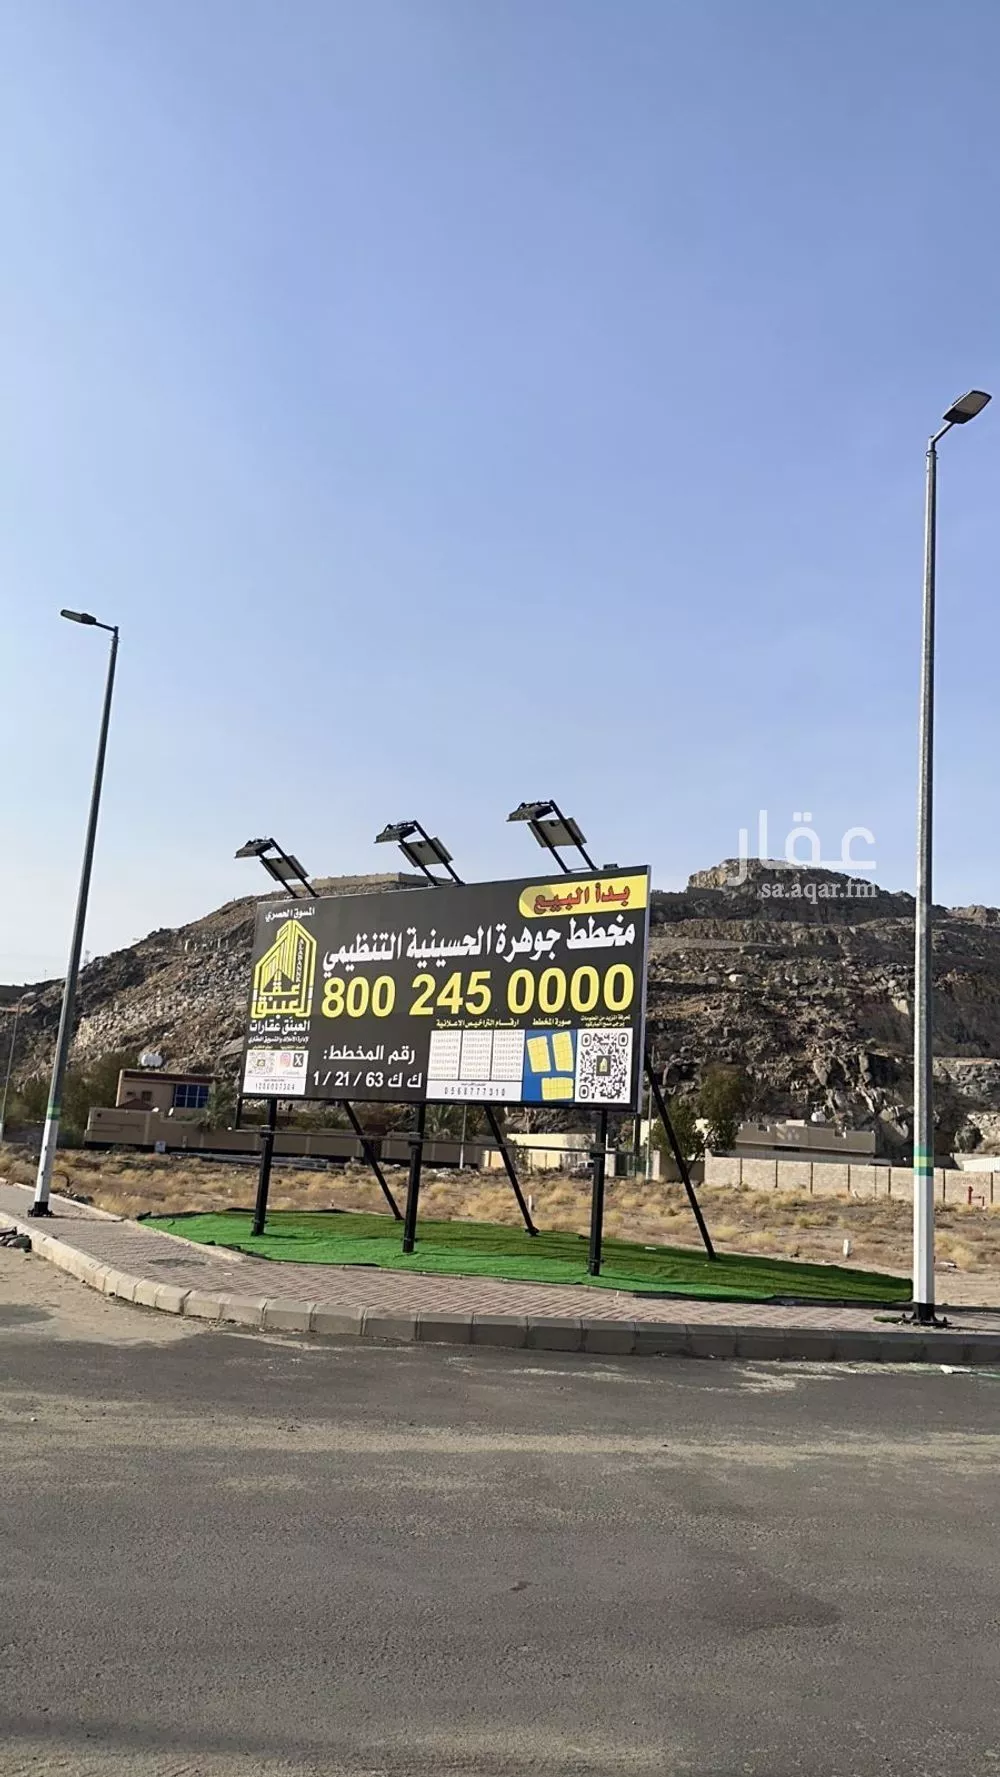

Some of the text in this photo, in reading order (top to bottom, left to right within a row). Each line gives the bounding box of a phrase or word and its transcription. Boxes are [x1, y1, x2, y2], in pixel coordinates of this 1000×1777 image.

[533, 882, 630, 915] بدأ البيع
[265, 909, 293, 922] الحصري
[322, 914, 636, 978] مخطط جوهرة الحسينية التنظيمي
[321, 963, 635, 1018] 800 245 0000
[249, 1019, 281, 1034] عقارات
[532, 1018, 571, 1027] صورة المخطط
[323, 1044, 384, 1061] المخطط:
[387, 1045, 415, 1065] رقم
[313, 1070, 320, 1086] 1
[334, 1071, 349, 1086] 21
[365, 1071, 384, 1087] 63
